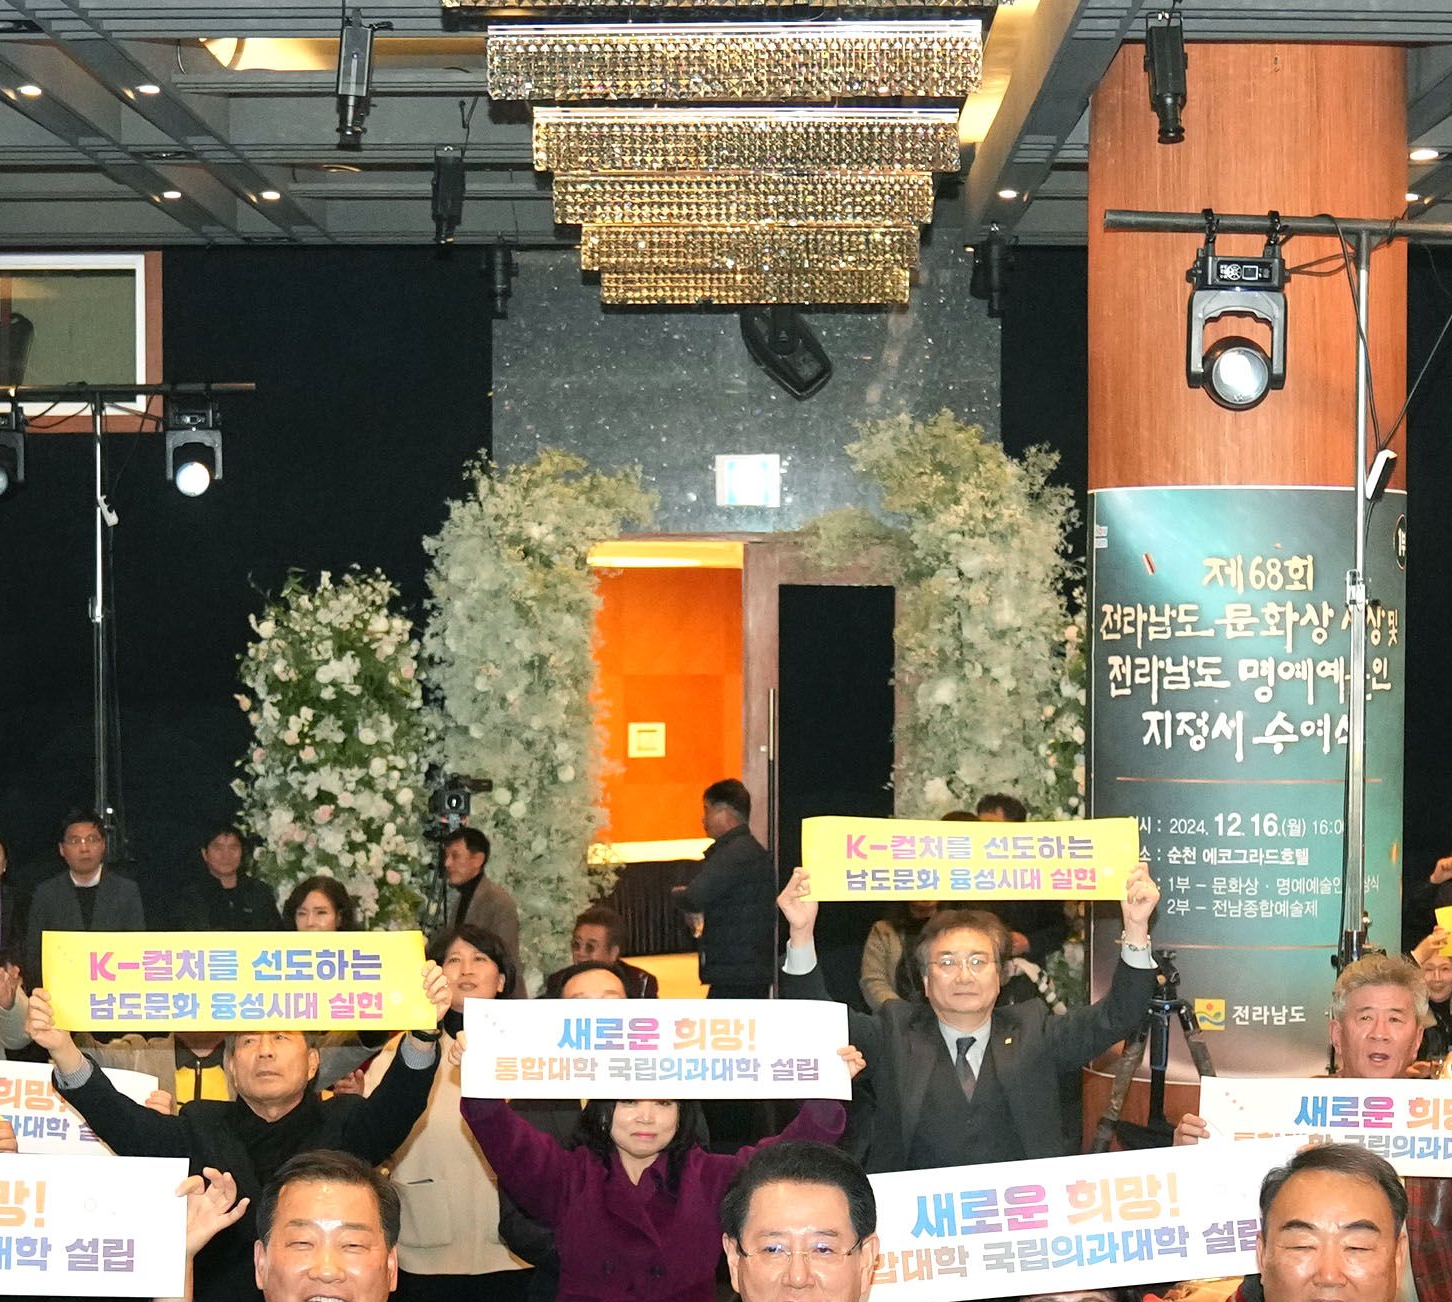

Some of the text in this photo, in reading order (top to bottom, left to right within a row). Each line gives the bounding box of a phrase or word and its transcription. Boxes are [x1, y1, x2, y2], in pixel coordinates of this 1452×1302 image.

[1202, 554, 1315, 594] 제68회
[1100, 602, 1215, 649] 전라남도
[1215, 601, 1334, 652] 문화상
[1341, 605, 1385, 646] 상
[1108, 654, 1391, 706] 전라남도 명예예인
[1142, 710, 1244, 762] 지정서
[1169, 818, 1209, 836] 2024.
[1214, 813, 1245, 837] 12.
[1312, 820, 1344, 836] 16:0
[846, 834, 1094, 861] K-컬처를 선도하는
[1167, 847, 1197, 865] 순천
[1202, 848, 1309, 866] 에코그라드호텔
[846, 867, 1097, 892] 남도문화 융성시대 실현
[1168, 877, 1191, 894] 1부
[1211, 878, 1259, 895] 문화상
[1167, 899, 1318, 918] 2부 전남종합예술제
[89, 949, 383, 982] K-컬처를 선도하는
[89, 992, 384, 1021] 남도문화 융성시대 실현
[1232, 1005, 1306, 1025] 전라남도
[557, 1017, 757, 1052] 새로운 희망!
[494, 1056, 820, 1082] 통합대학 국립의과대학 설립
[1293, 1095, 1394, 1129] 새로운
[910, 1171, 1181, 1239] 새로운 희망!
[64, 1235, 135, 1274] 설립
[872, 1218, 1262, 1285] 합대학 국립의과대학 설립
